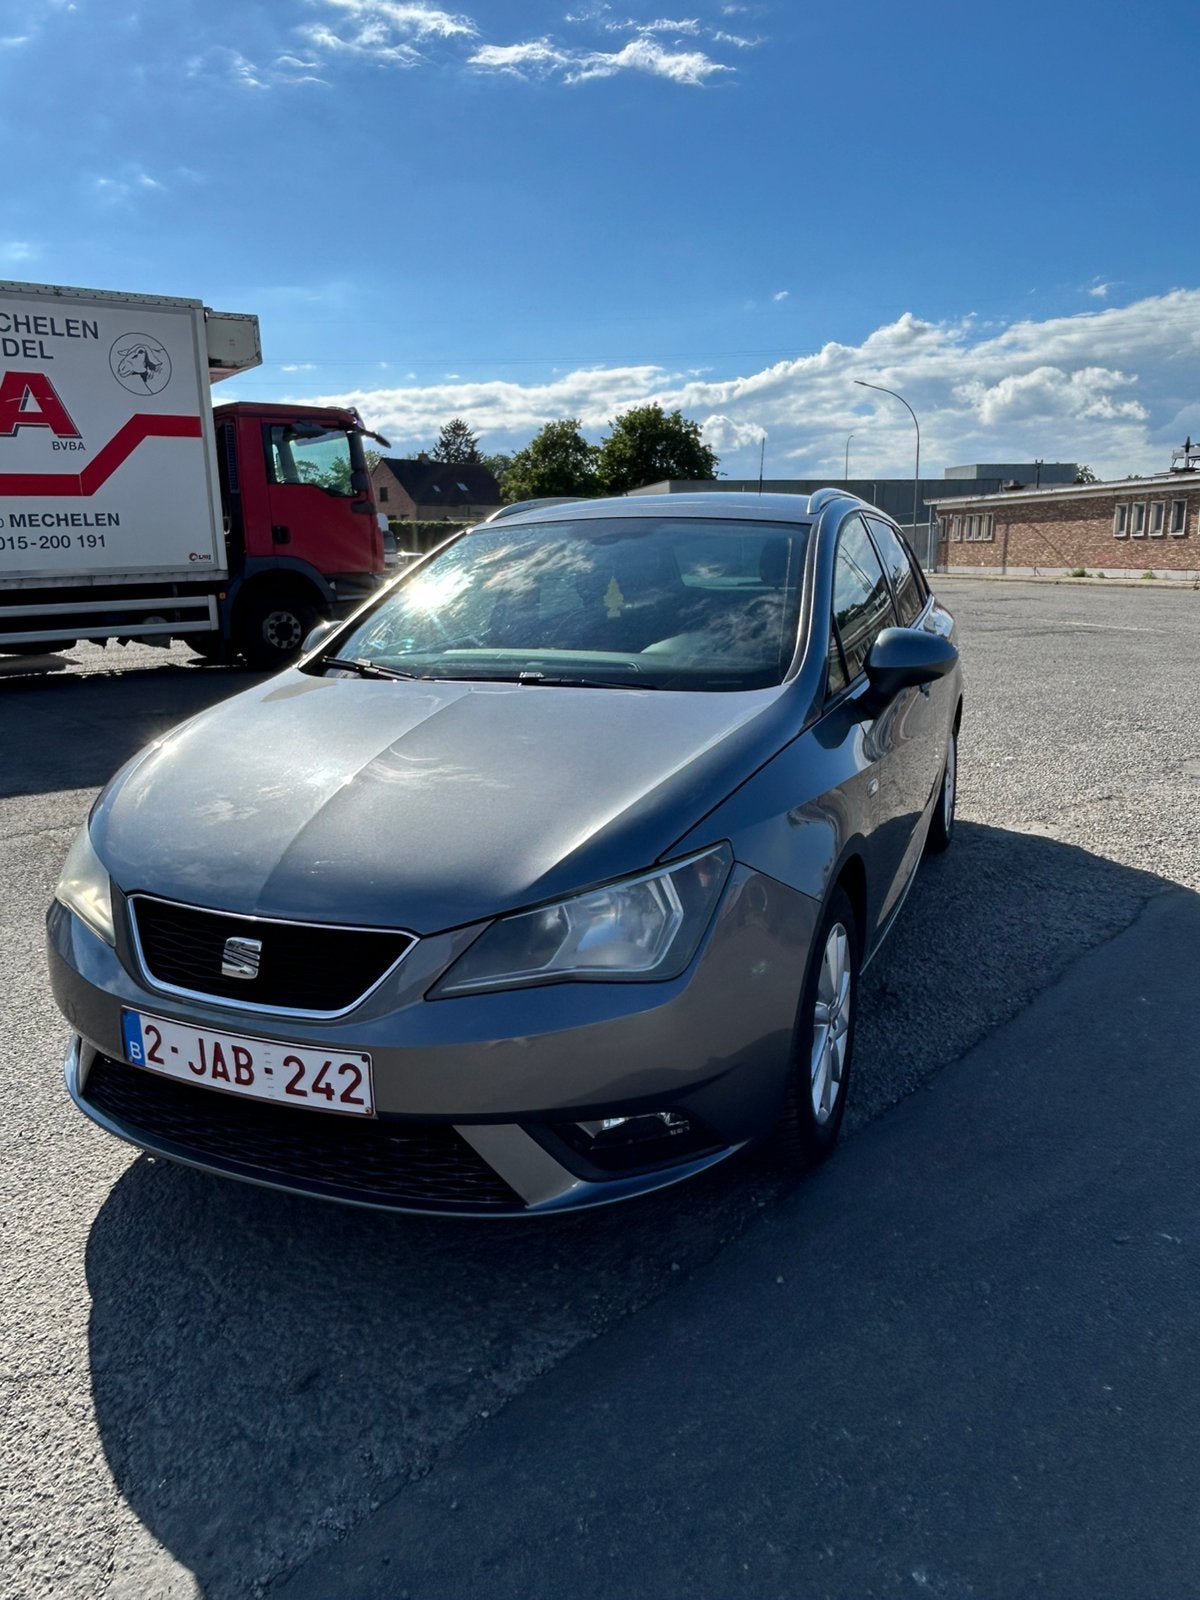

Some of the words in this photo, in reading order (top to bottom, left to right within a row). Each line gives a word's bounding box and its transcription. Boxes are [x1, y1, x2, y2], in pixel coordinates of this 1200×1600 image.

[0, 312, 99, 339] CHELEN
[2, 337, 54, 359] DEL
[52, 441, 86, 451] BVBA
[9, 513, 120, 528] MECHELEN
[77, 534, 105, 548] 191
[129, 1041, 142, 1059] B
[145, 1024, 365, 1105] 2-JAB-242
